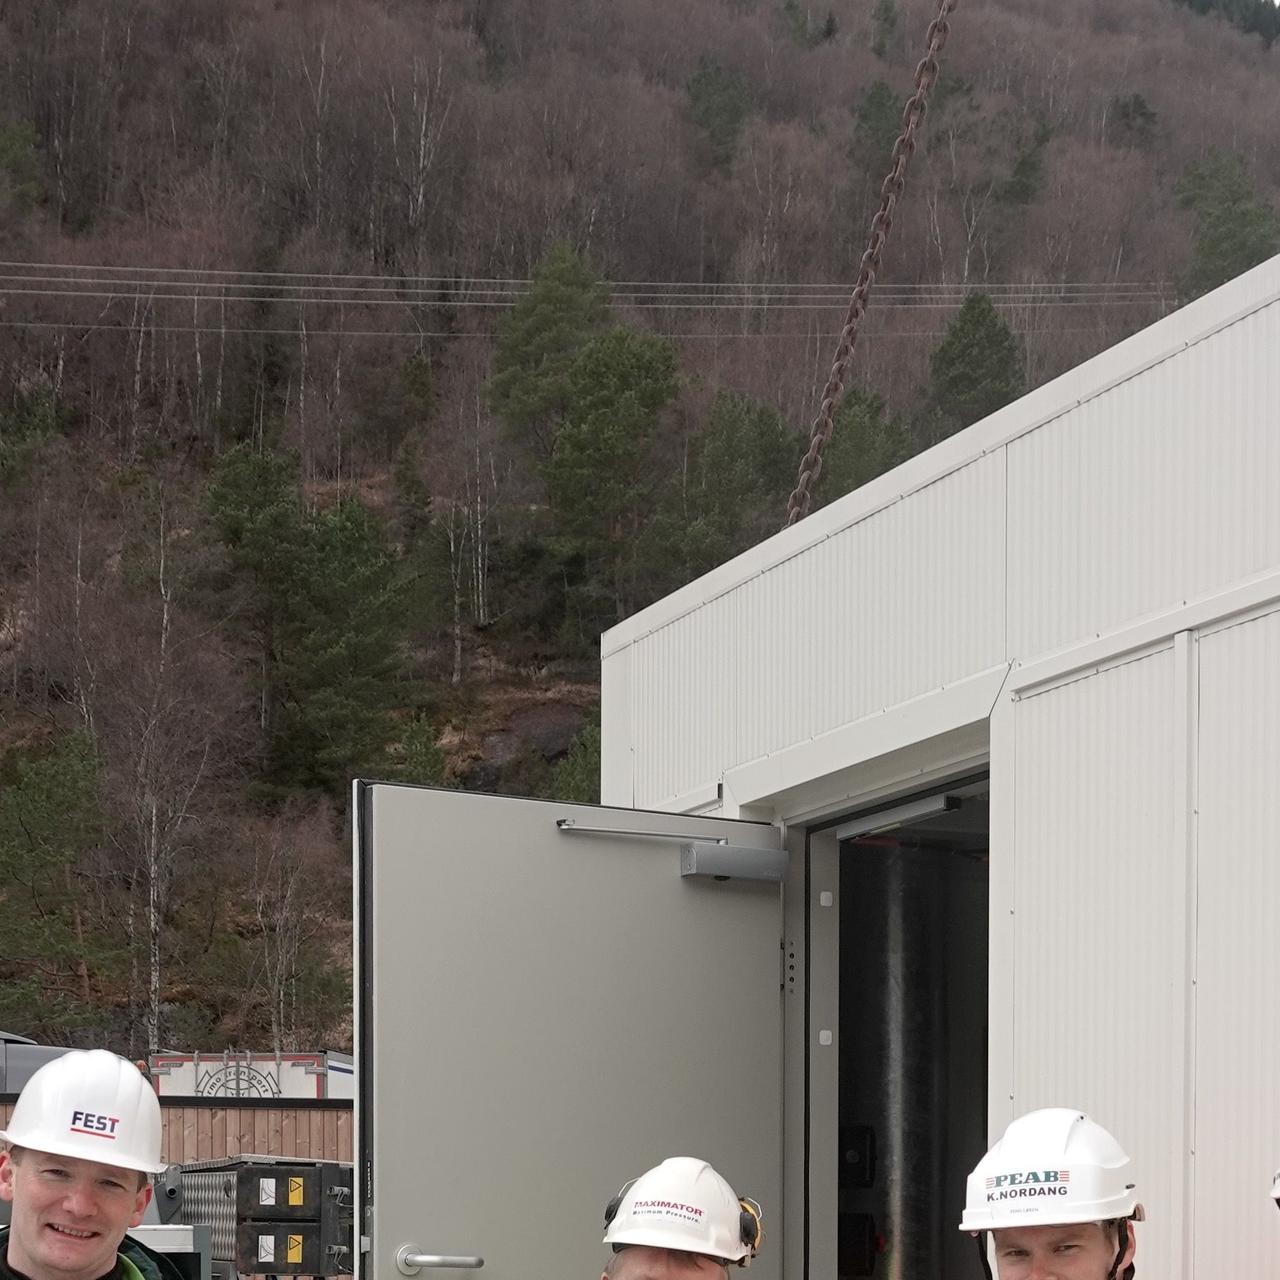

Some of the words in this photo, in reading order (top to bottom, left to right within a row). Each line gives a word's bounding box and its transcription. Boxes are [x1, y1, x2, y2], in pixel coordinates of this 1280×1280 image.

[72, 1111, 120, 1133] FEST
[994, 1171, 1059, 1188] PEAB
[634, 1200, 703, 1217] MAXIMATOR
